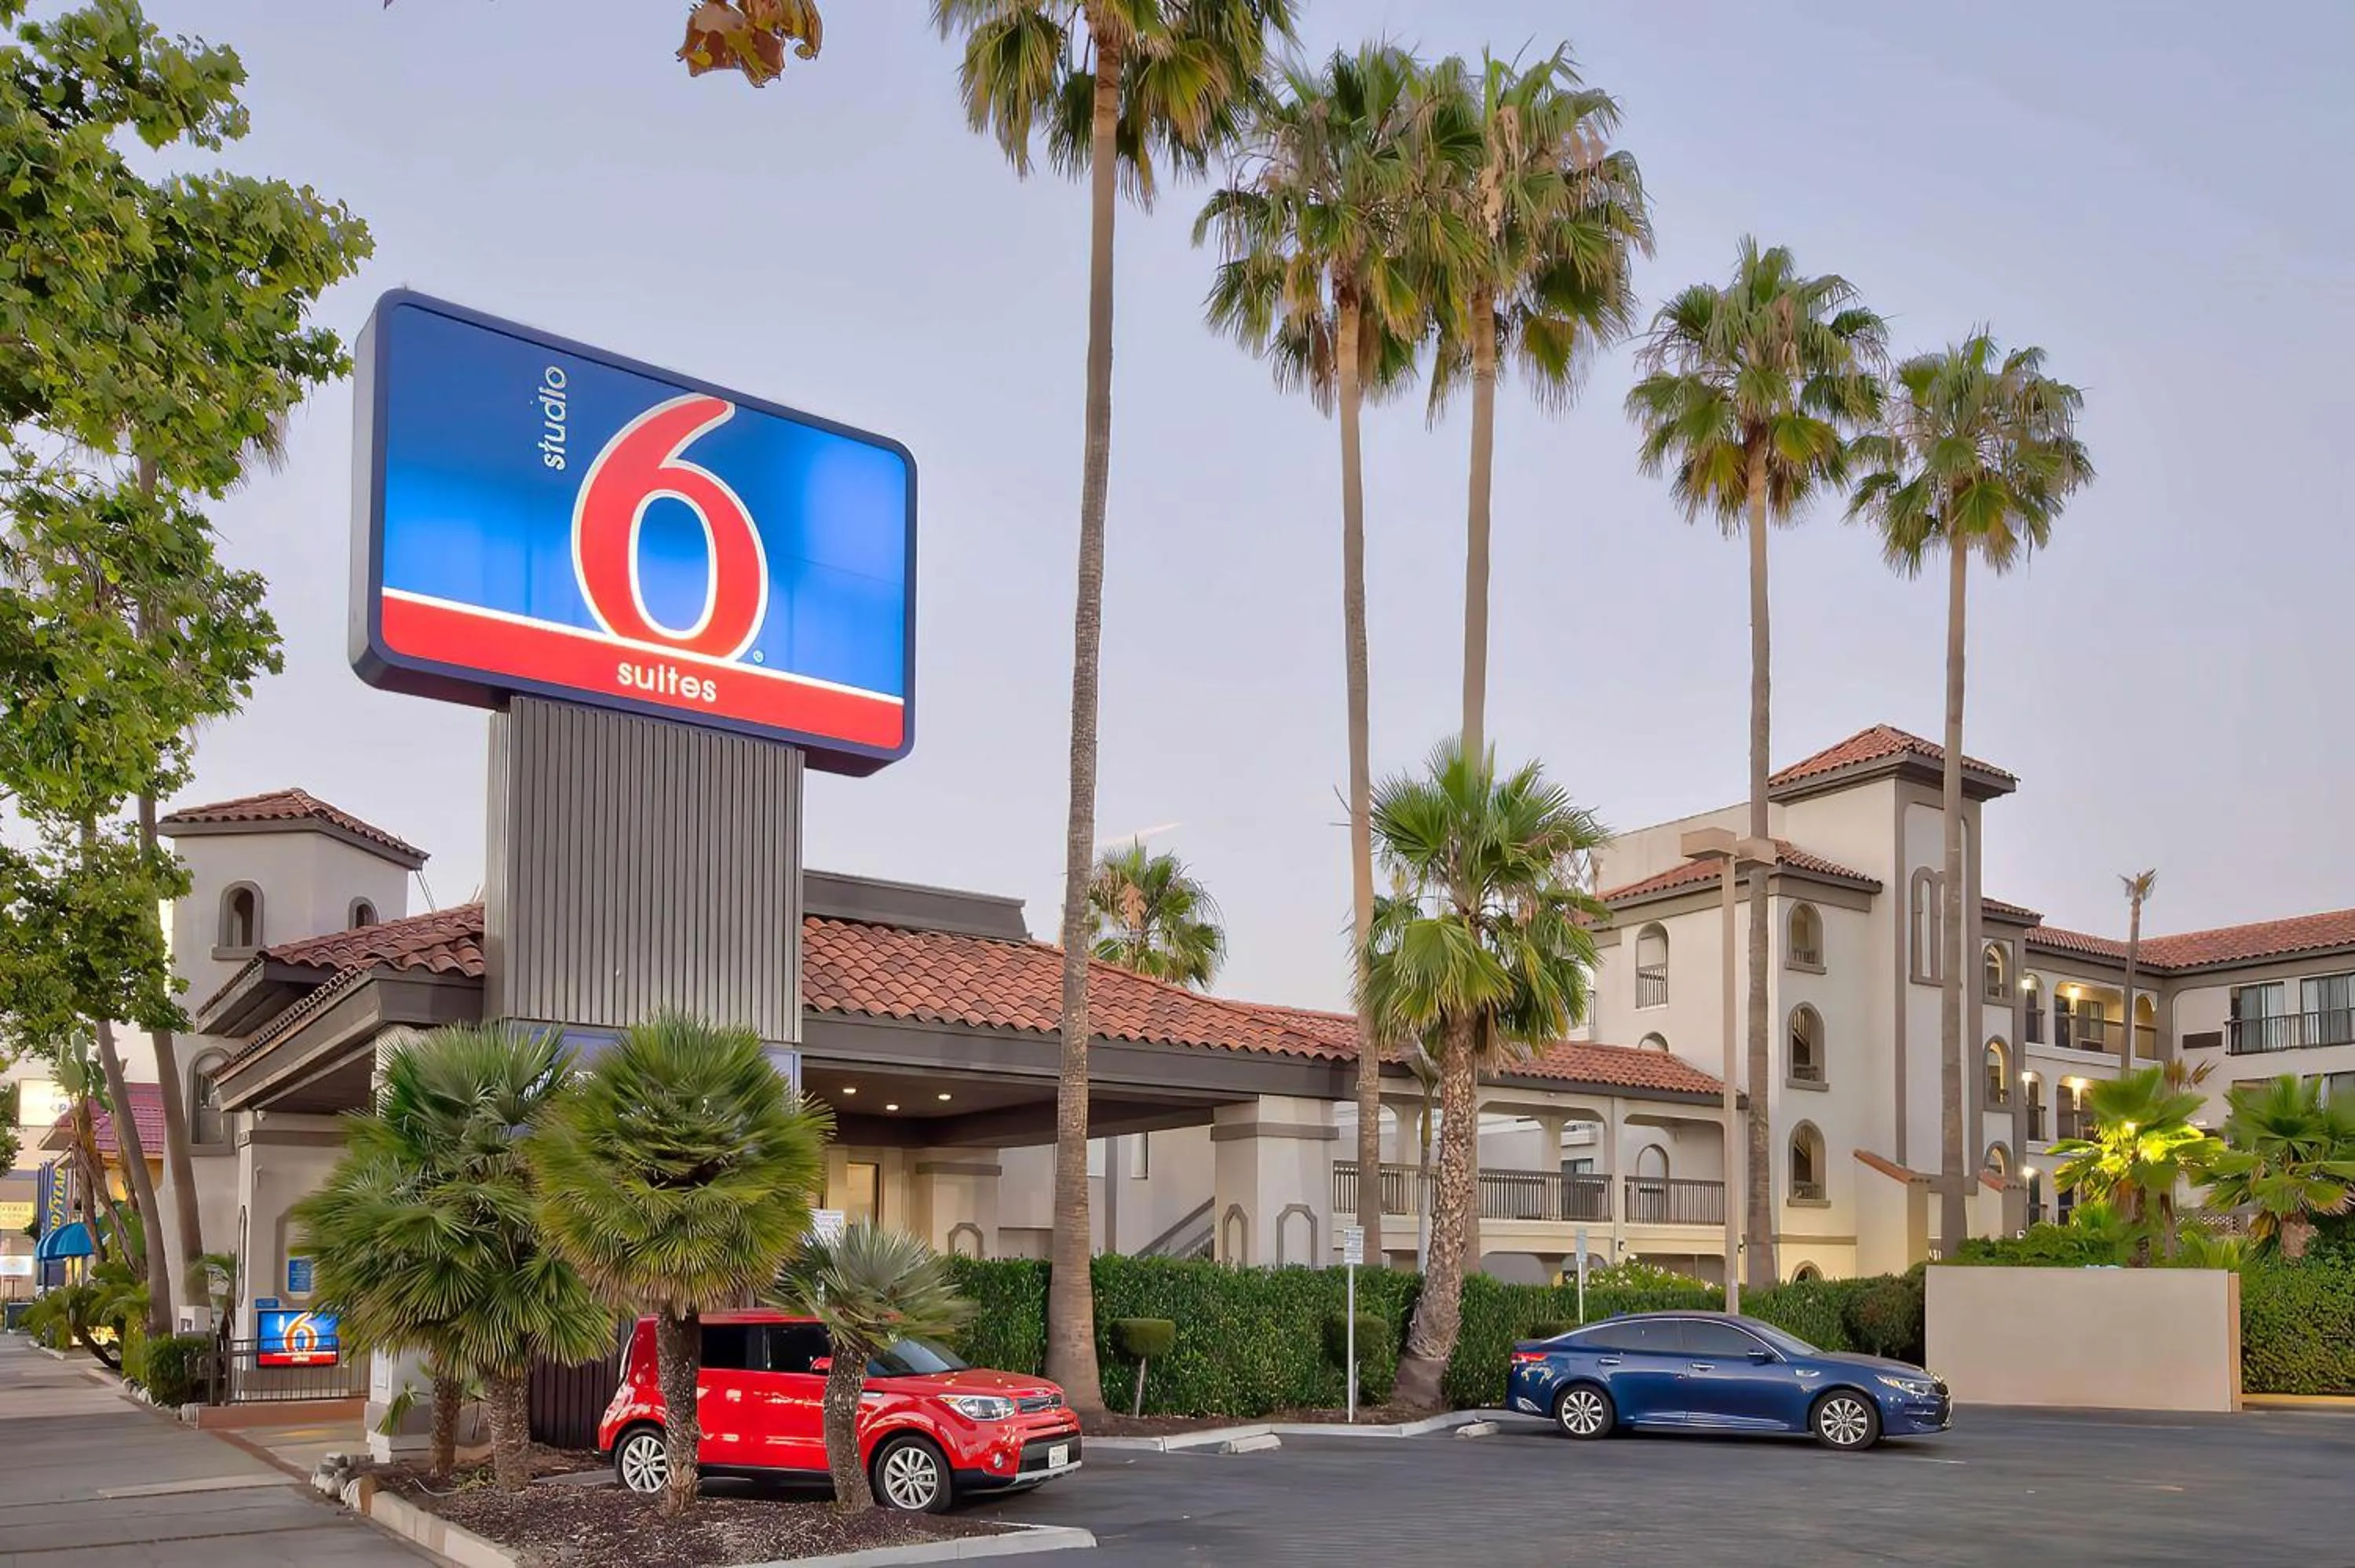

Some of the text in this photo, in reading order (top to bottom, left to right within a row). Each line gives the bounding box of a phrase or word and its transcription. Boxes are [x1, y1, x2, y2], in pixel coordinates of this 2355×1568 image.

[538, 366, 566, 470] studio
[571, 392, 769, 664] 6
[616, 662, 717, 703] suites
[283, 1311, 319, 1352] 6
